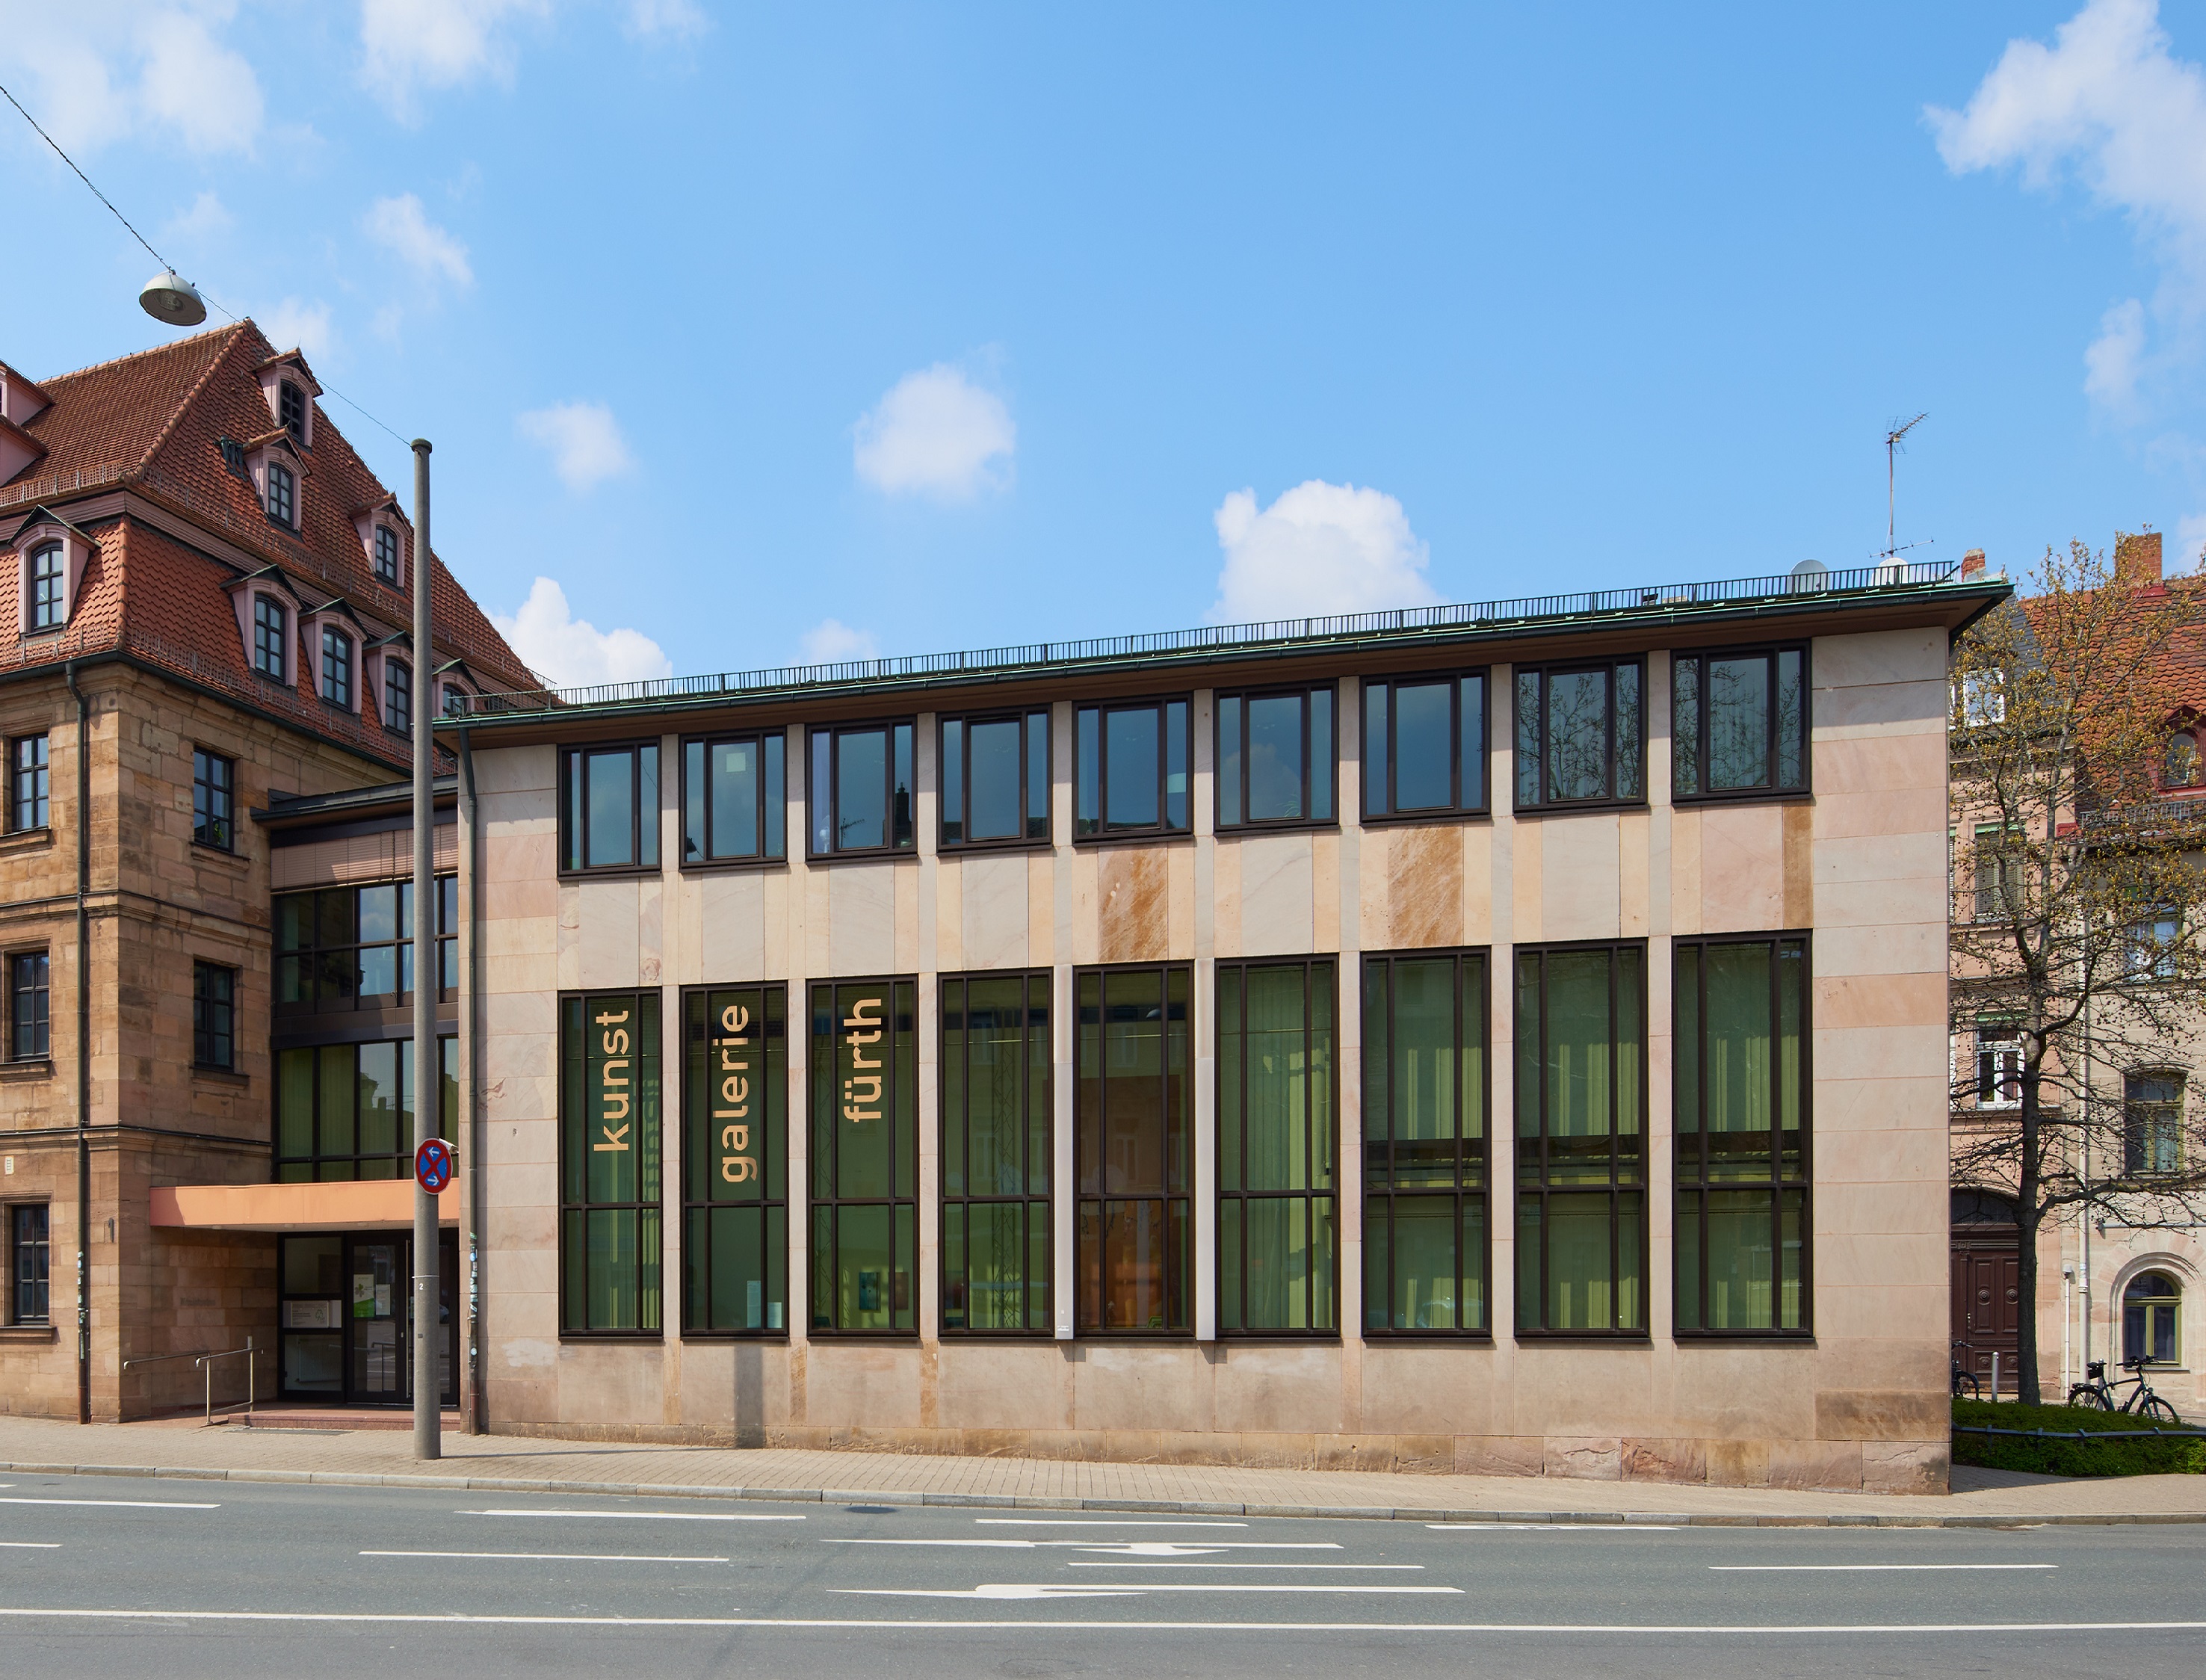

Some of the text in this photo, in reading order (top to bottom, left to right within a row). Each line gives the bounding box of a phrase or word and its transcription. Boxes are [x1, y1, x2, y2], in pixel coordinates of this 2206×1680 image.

[593, 1010, 629, 1152] kunst
[713, 1005, 758, 1182] galerie
[843, 998, 882, 1122] fürth
[418, 1282, 424, 1291] 2
